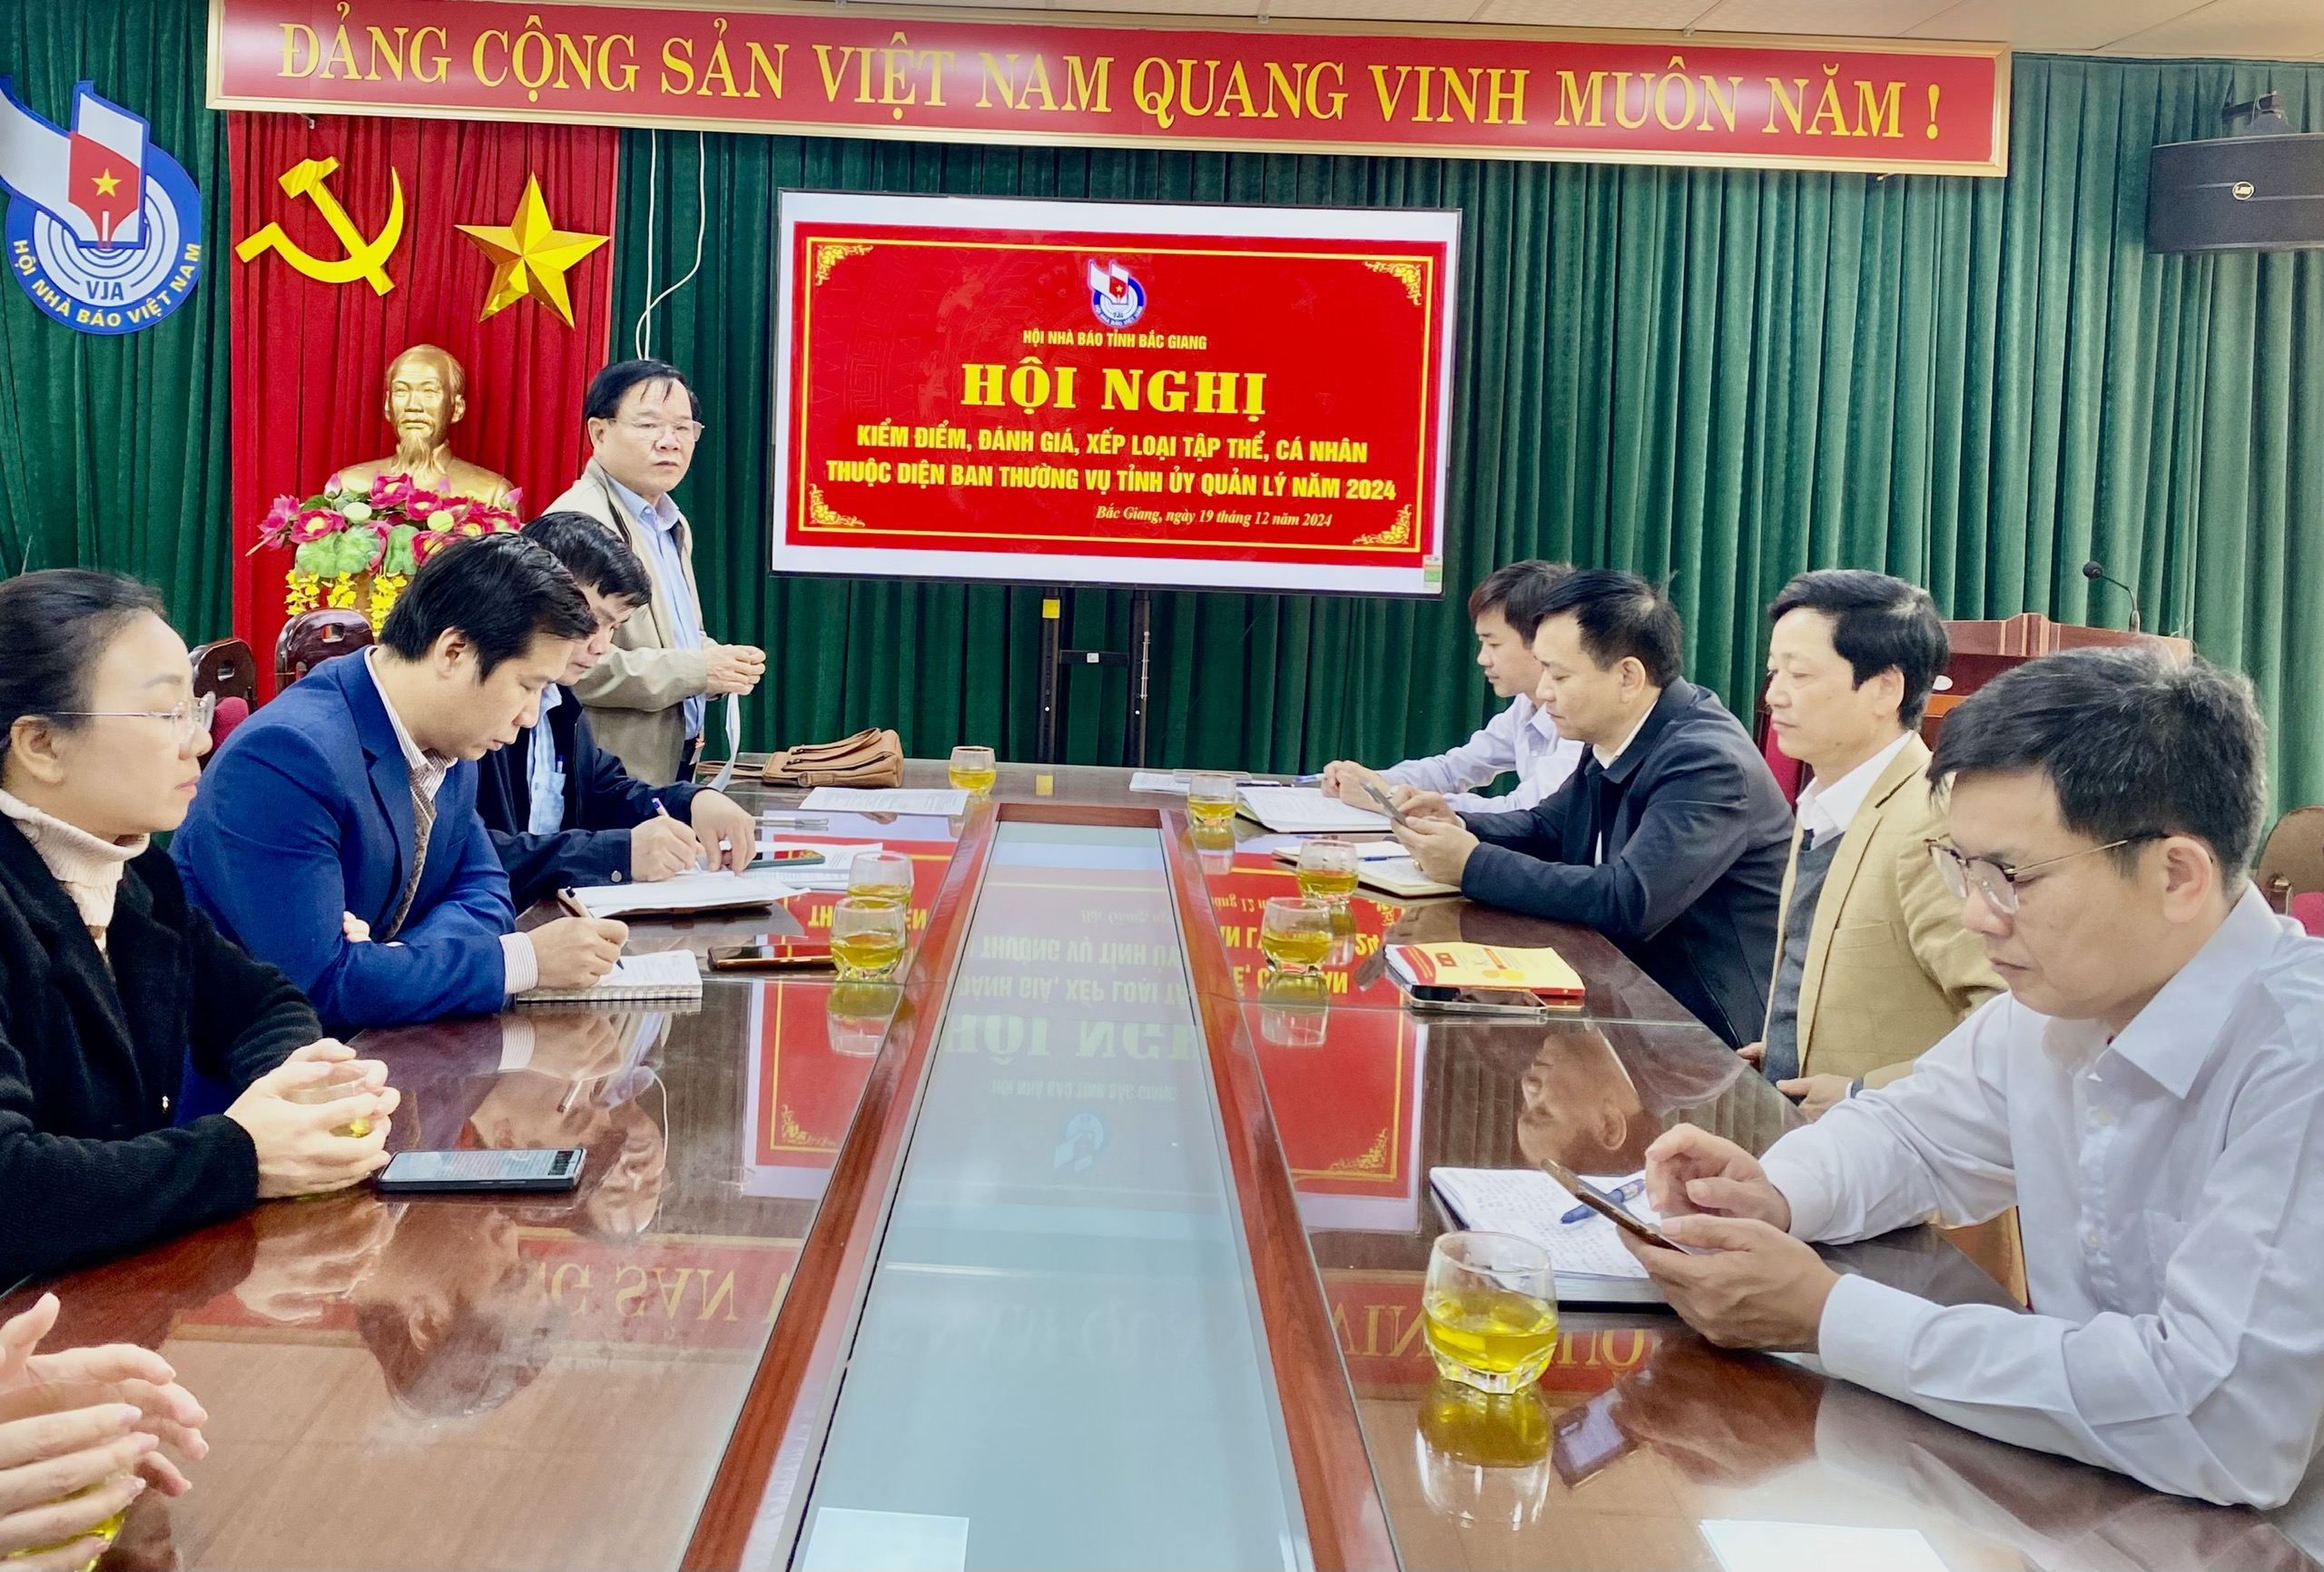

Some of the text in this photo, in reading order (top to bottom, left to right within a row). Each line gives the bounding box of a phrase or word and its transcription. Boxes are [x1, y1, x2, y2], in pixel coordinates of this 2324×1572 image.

[276, 1, 1941, 140] ĐẢNG CỘNG SẢN VIỆT NAM QUANG VINH MUÔN NĂM !
[13, 240, 202, 328] HỘI NHÀ BÁO VIỆT NAM
[85, 280, 124, 301] VJA
[1022, 328, 1207, 350] HỘI NHÀ BÁO TỈNH BẮC GIANG
[960, 356, 1267, 422] HỘI NGHỊ
[857, 418, 1368, 464] KIỂM ĐIỂM, ĐÁNH GIÁ, XẾP LOẠI TẬP THỂ, CÁ NHÂN
[826, 457, 1397, 501] THUỘC DIỆN BAN THƯỜNG VỤ TỈNH ỦY QUẢN LÝ NĂM 2024
[1095, 505, 1334, 528] Bắc Giang, ngày 19 tháng 12 năm 2024
